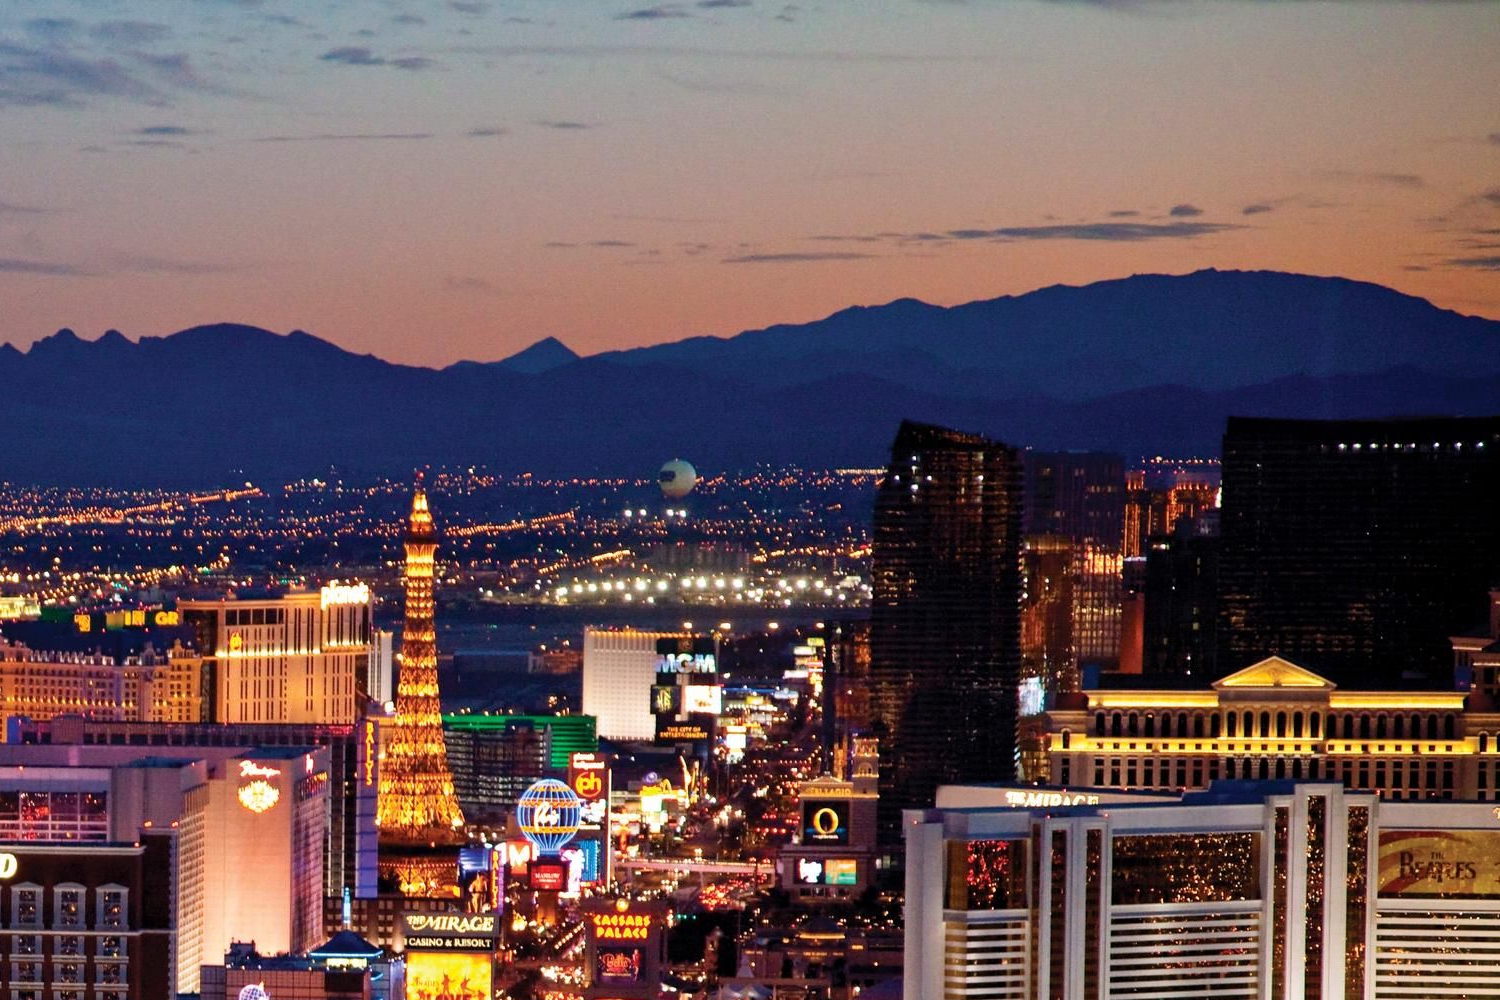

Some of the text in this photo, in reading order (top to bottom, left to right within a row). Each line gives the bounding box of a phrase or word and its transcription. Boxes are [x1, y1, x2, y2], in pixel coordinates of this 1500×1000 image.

[655, 653, 716, 673] MGM
[418, 916, 494, 933] MIRAGE
[594, 914, 651, 926] CAESARS
[596, 926, 648, 939] PALACE
[409, 937, 444, 947] CASINO
[445, 938, 453, 947] &
[454, 938, 492, 948] RESORT
